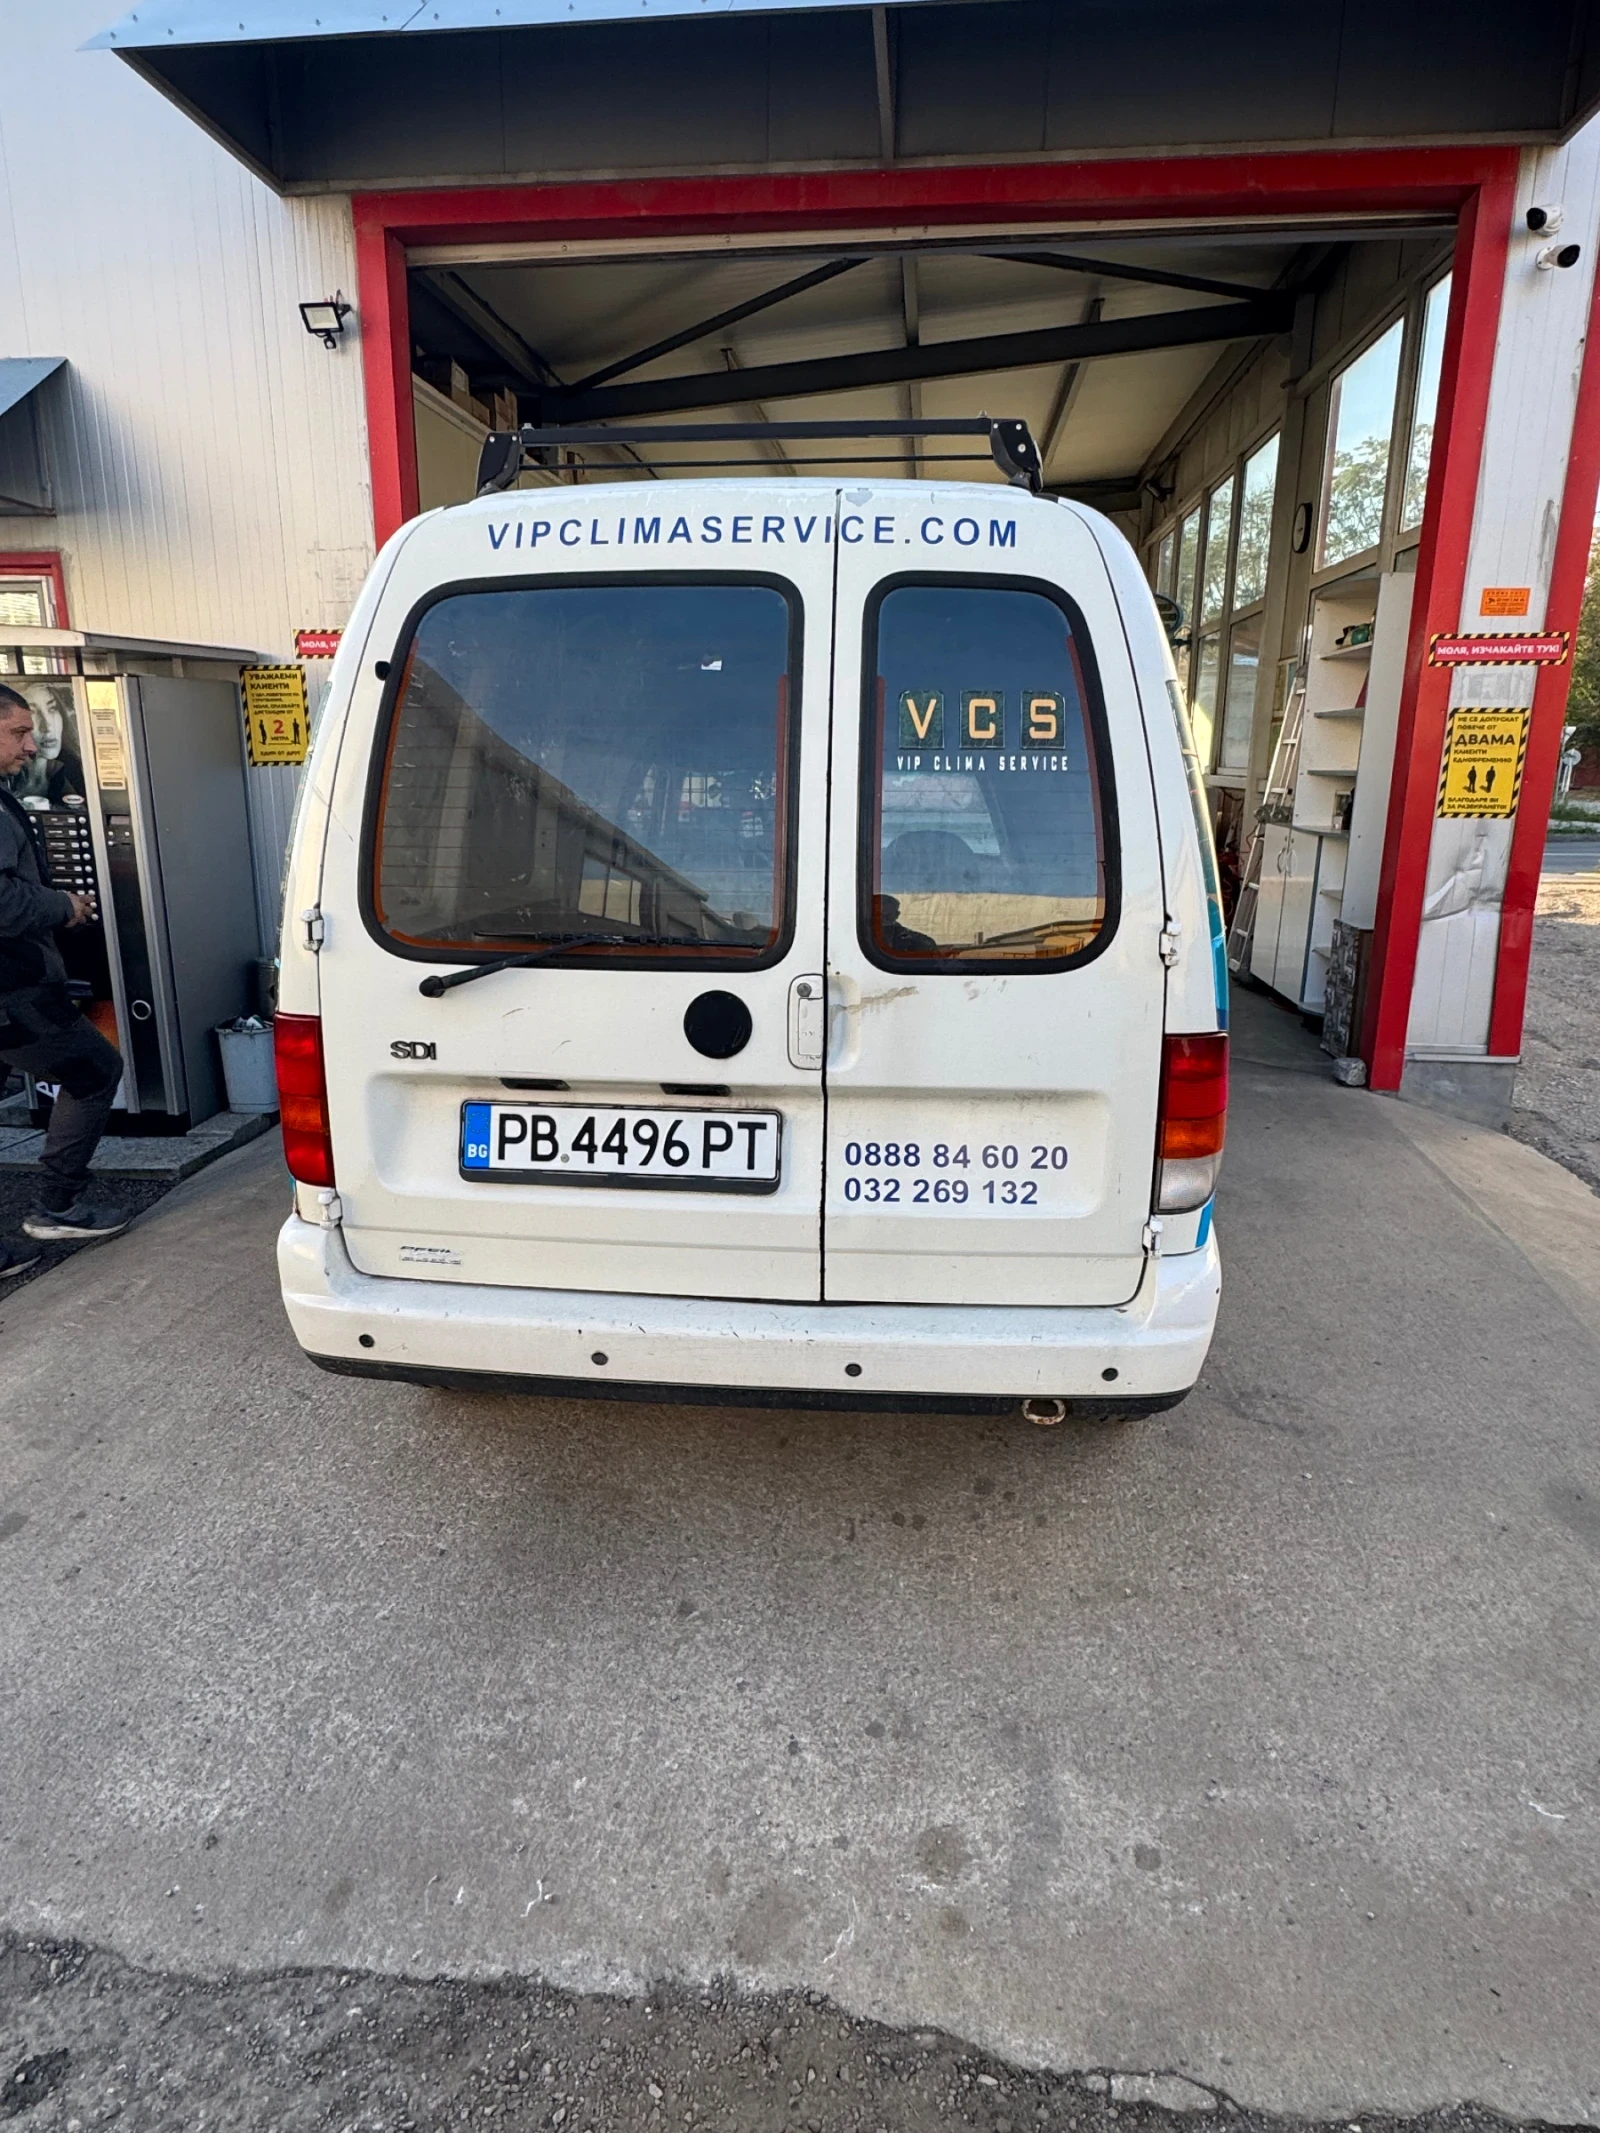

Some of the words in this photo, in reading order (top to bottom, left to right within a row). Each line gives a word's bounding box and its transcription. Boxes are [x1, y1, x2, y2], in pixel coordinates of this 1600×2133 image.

[488, 515, 1017, 550] VIPCLIMASERVICE.COM
[301, 640, 329, 649] МОЛЯ,
[1437, 646, 1469, 656] МОЛЯ,
[1471, 643, 1534, 655] ИЗЧАКАЙТЕ
[1536, 644, 1560, 654] ТУК!
[248, 672, 298, 681] УВАЖАЕМИ
[250, 682, 290, 690] КЛИЕНТИ
[272, 719, 285, 734] 2
[1454, 733, 1516, 747] ДВАМА
[896, 756, 922, 772] VIP
[933, 756, 986, 772] CLIMA
[998, 756, 1069, 772] SERVICE
[390, 1040, 437, 1061] SDI
[467, 1143, 488, 1159] BG
[844, 1142, 921, 1168] 0888
[932, 1143, 971, 1169] 84
[981, 1144, 1019, 1169] 60
[1030, 1145, 1068, 1170] 20
[844, 1177, 901, 1203] 032
[912, 1178, 969, 1204] 269
[982, 1180, 1038, 1205] 132
